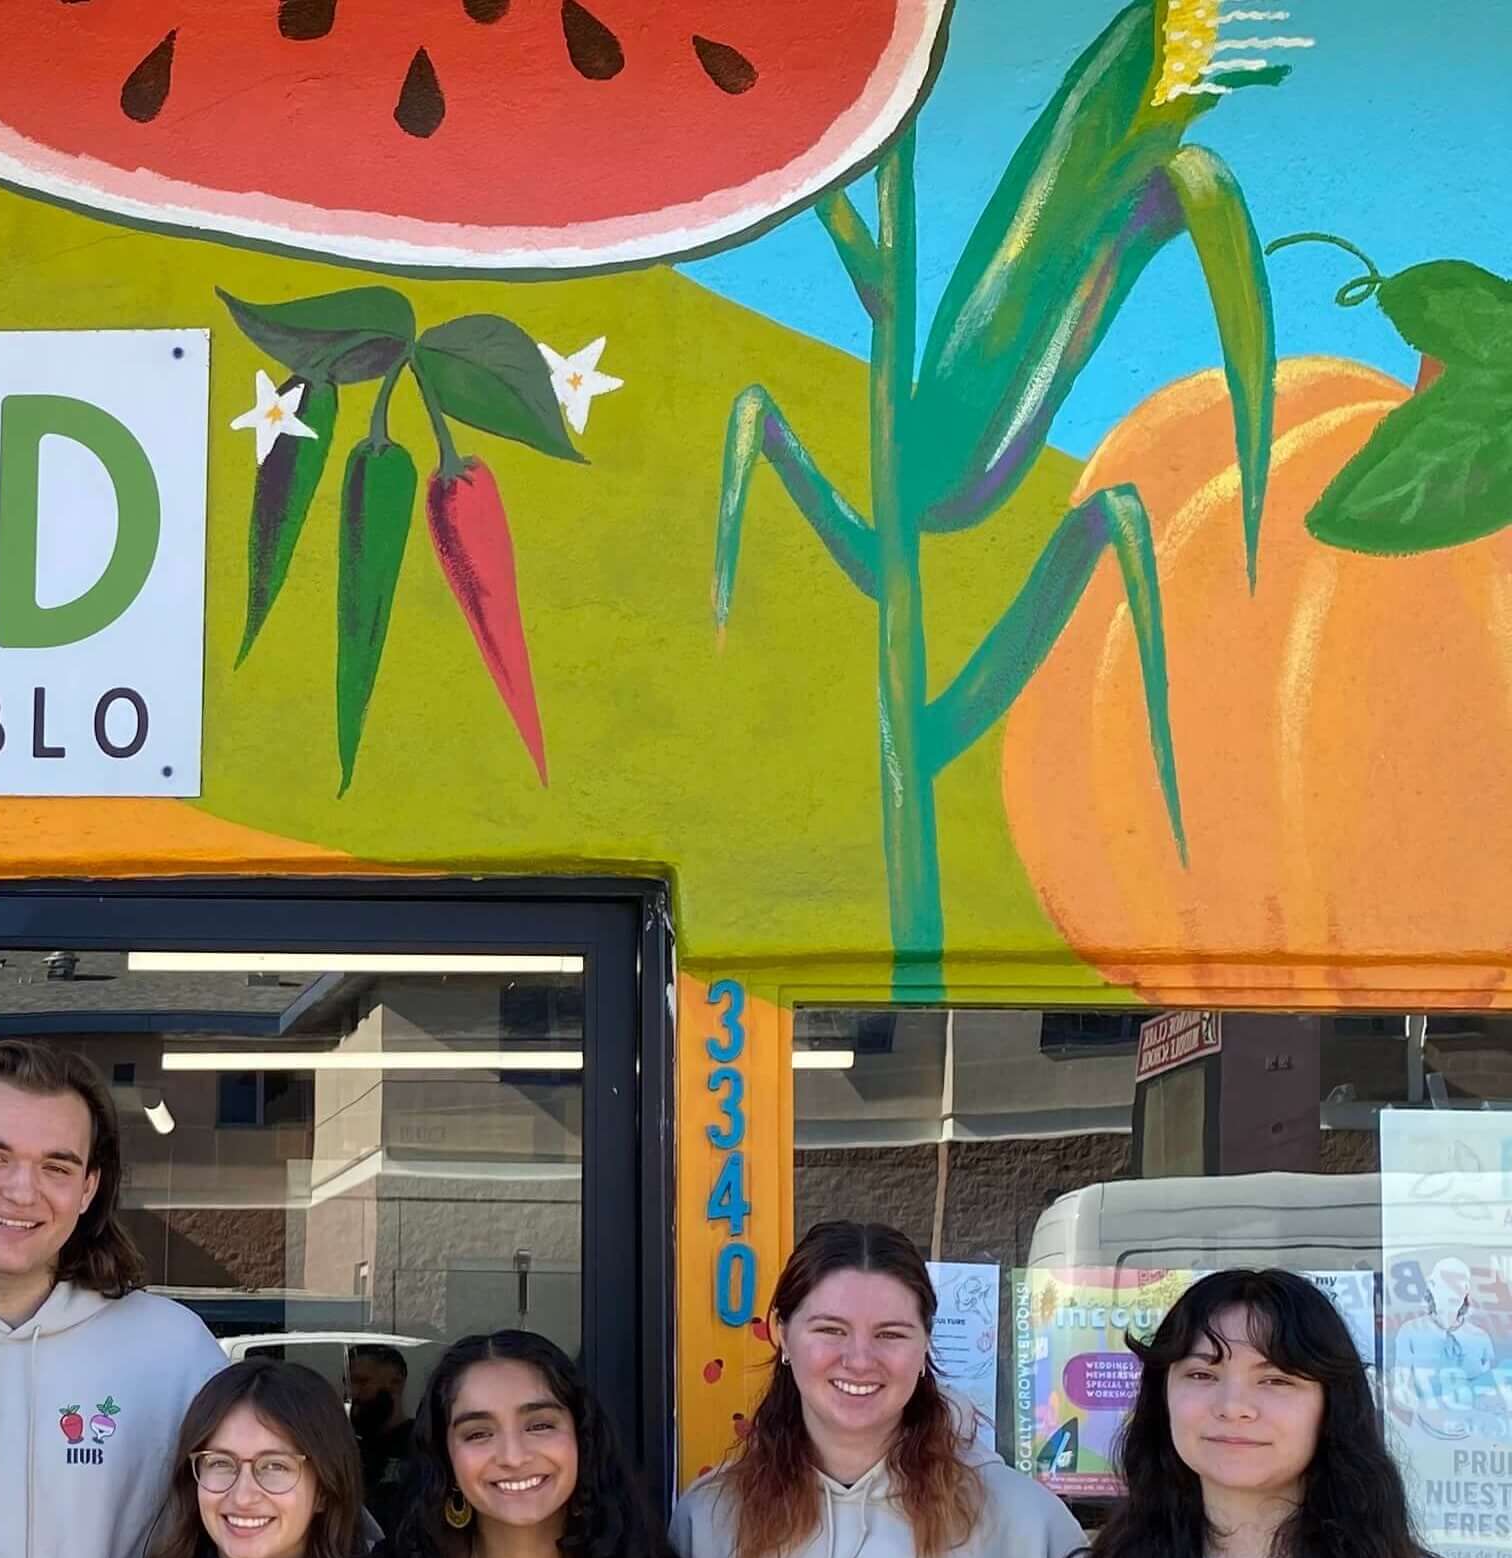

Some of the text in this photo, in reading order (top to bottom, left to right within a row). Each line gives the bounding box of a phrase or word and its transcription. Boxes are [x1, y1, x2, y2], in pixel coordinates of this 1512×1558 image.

[705, 978, 758, 1328] 3340
[1018, 1353, 1032, 1411] GROWN
[1085, 1360, 1135, 1370] WEDDINGS
[1085, 1379, 1123, 1389] SPECIAL
[66, 1447, 104, 1465] HUB
[1019, 1415, 1033, 1472] OCALLY
